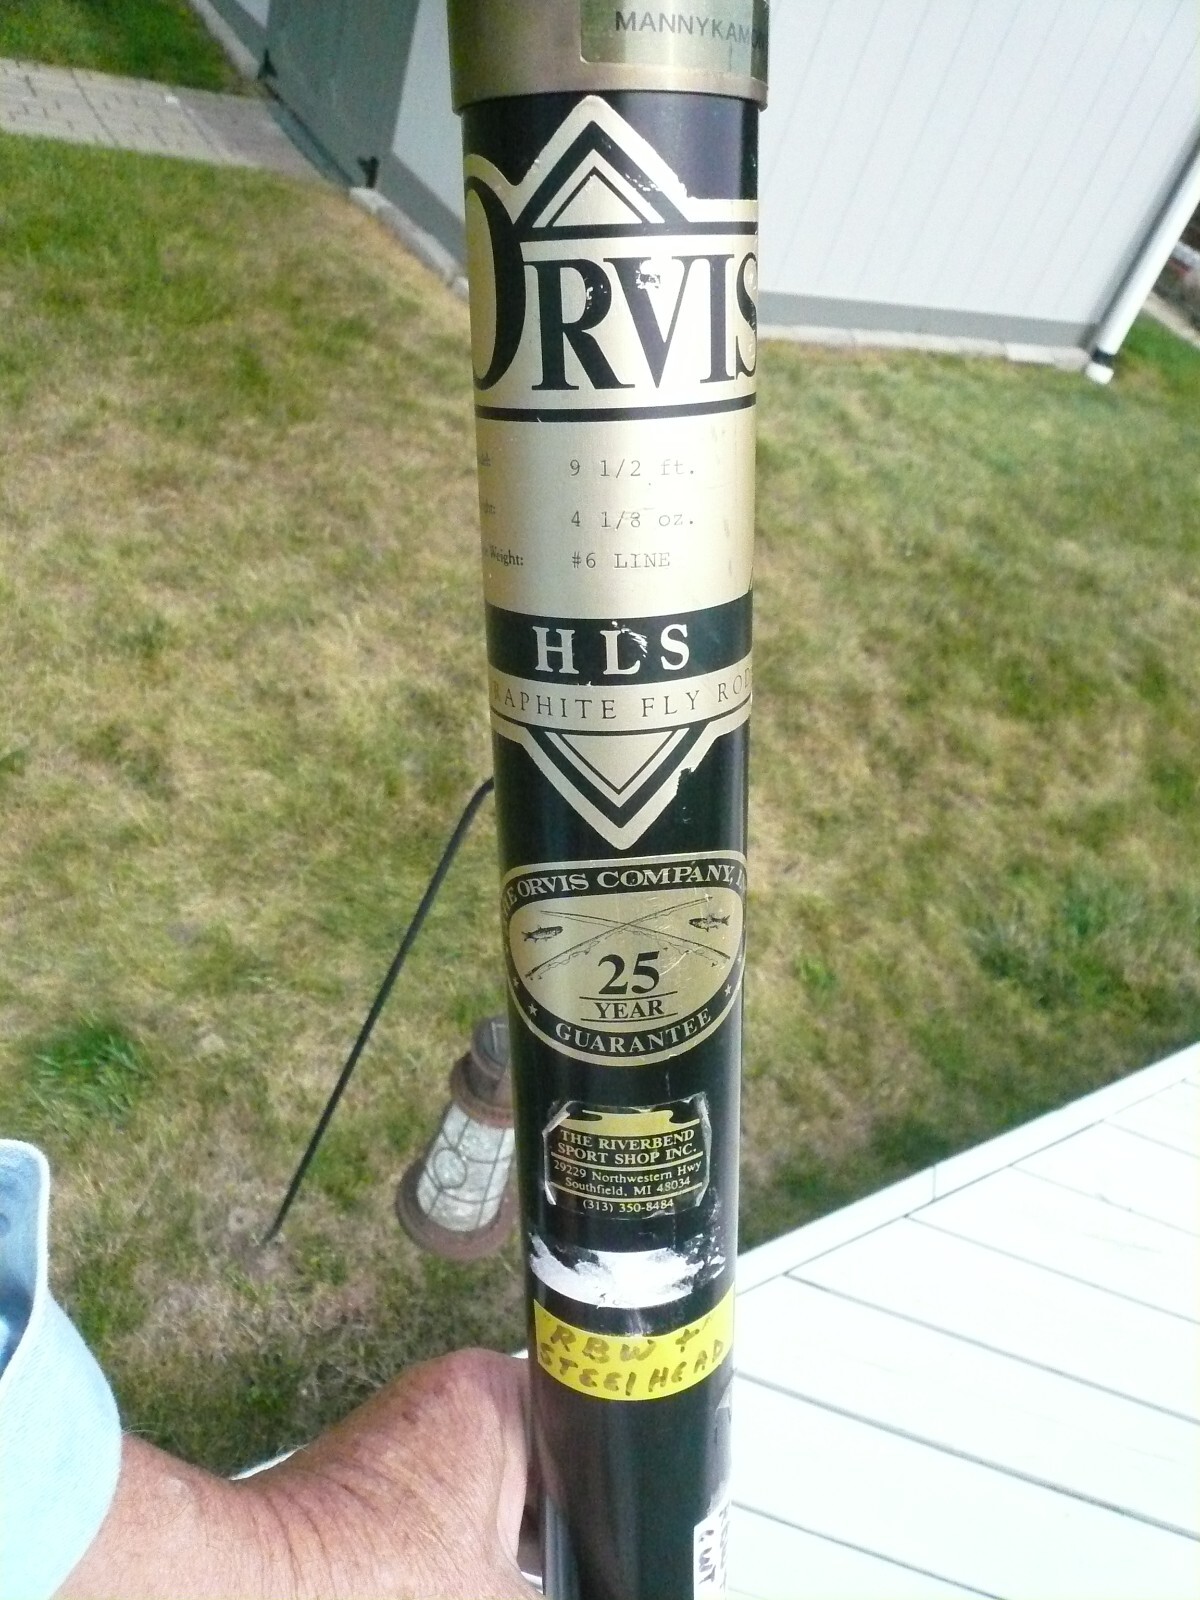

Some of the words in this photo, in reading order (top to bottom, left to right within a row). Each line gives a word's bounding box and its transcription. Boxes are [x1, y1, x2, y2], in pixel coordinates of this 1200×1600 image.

[614, 10, 766, 50] MANNYKAM
[570, 459, 581, 476] 9
[600, 458, 641, 478] 1/2
[660, 458, 695, 476] ft.
[570, 510, 582, 527] 4
[600, 510, 641, 531] 1/8
[657, 514, 695, 527] oz.
[571, 552, 597, 569] #6
[613, 552, 671, 569] LINE
[490, 680, 617, 719] RAPHITE
[641, 690, 700, 718] FLY
[517, 873, 588, 897] ORVIS
[597, 863, 735, 888] COMPANY,
[597, 950, 660, 995] 25
[594, 999, 665, 1019] YEAR
[555, 1007, 711, 1054] GUARANTEE
[560, 1129, 593, 1147] THE
[599, 1129, 695, 1150] RIVERBEND
[557, 1142, 608, 1164] SPORT
[614, 1151, 660, 1165] SHOP
[665, 1142, 697, 1161] INC.
[553, 1159, 587, 1178] 29229
[592, 1171, 672, 1184] Northwestern
[677, 1160, 702, 1176] Hwy
[633, 1185, 652, 1195] MI
[656, 1176, 691, 1193] 48034
[583, 1199, 614, 1213] (313)
[619, 1198, 674, 1213] 350-8484
[550, 1324, 656, 1364] RBW
